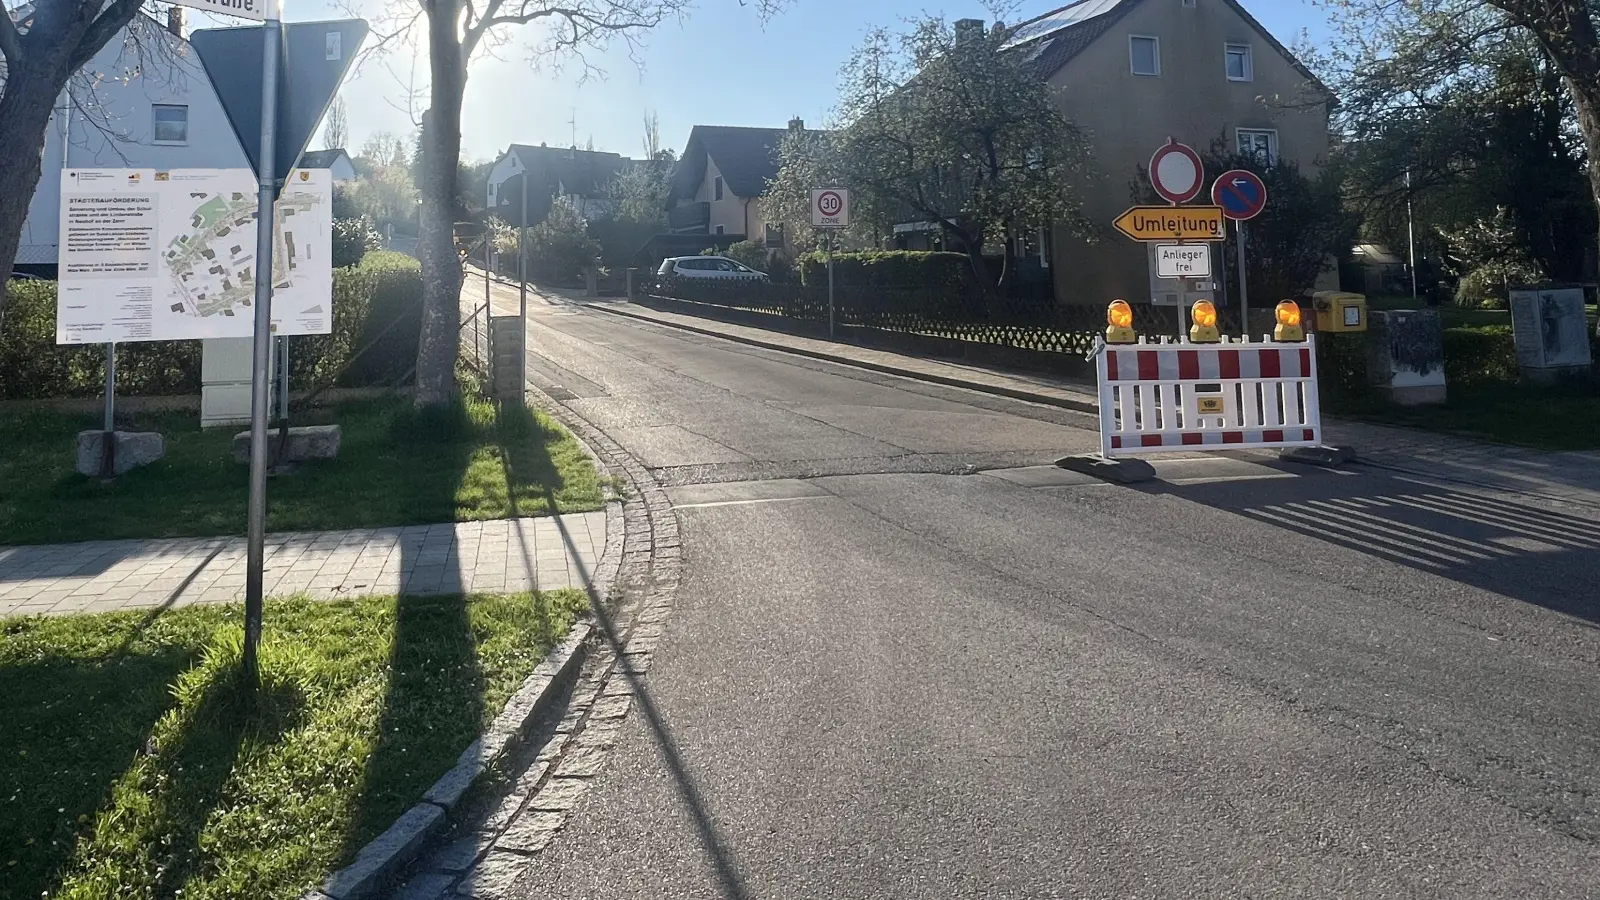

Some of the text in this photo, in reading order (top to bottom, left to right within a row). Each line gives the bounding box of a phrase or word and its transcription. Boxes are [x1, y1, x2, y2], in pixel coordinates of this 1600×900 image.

[823, 197, 838, 209] 30
[1133, 216, 1218, 234] Umleitung
[1163, 250, 1203, 261] Anlieger
[1176, 262, 1192, 272] frei
